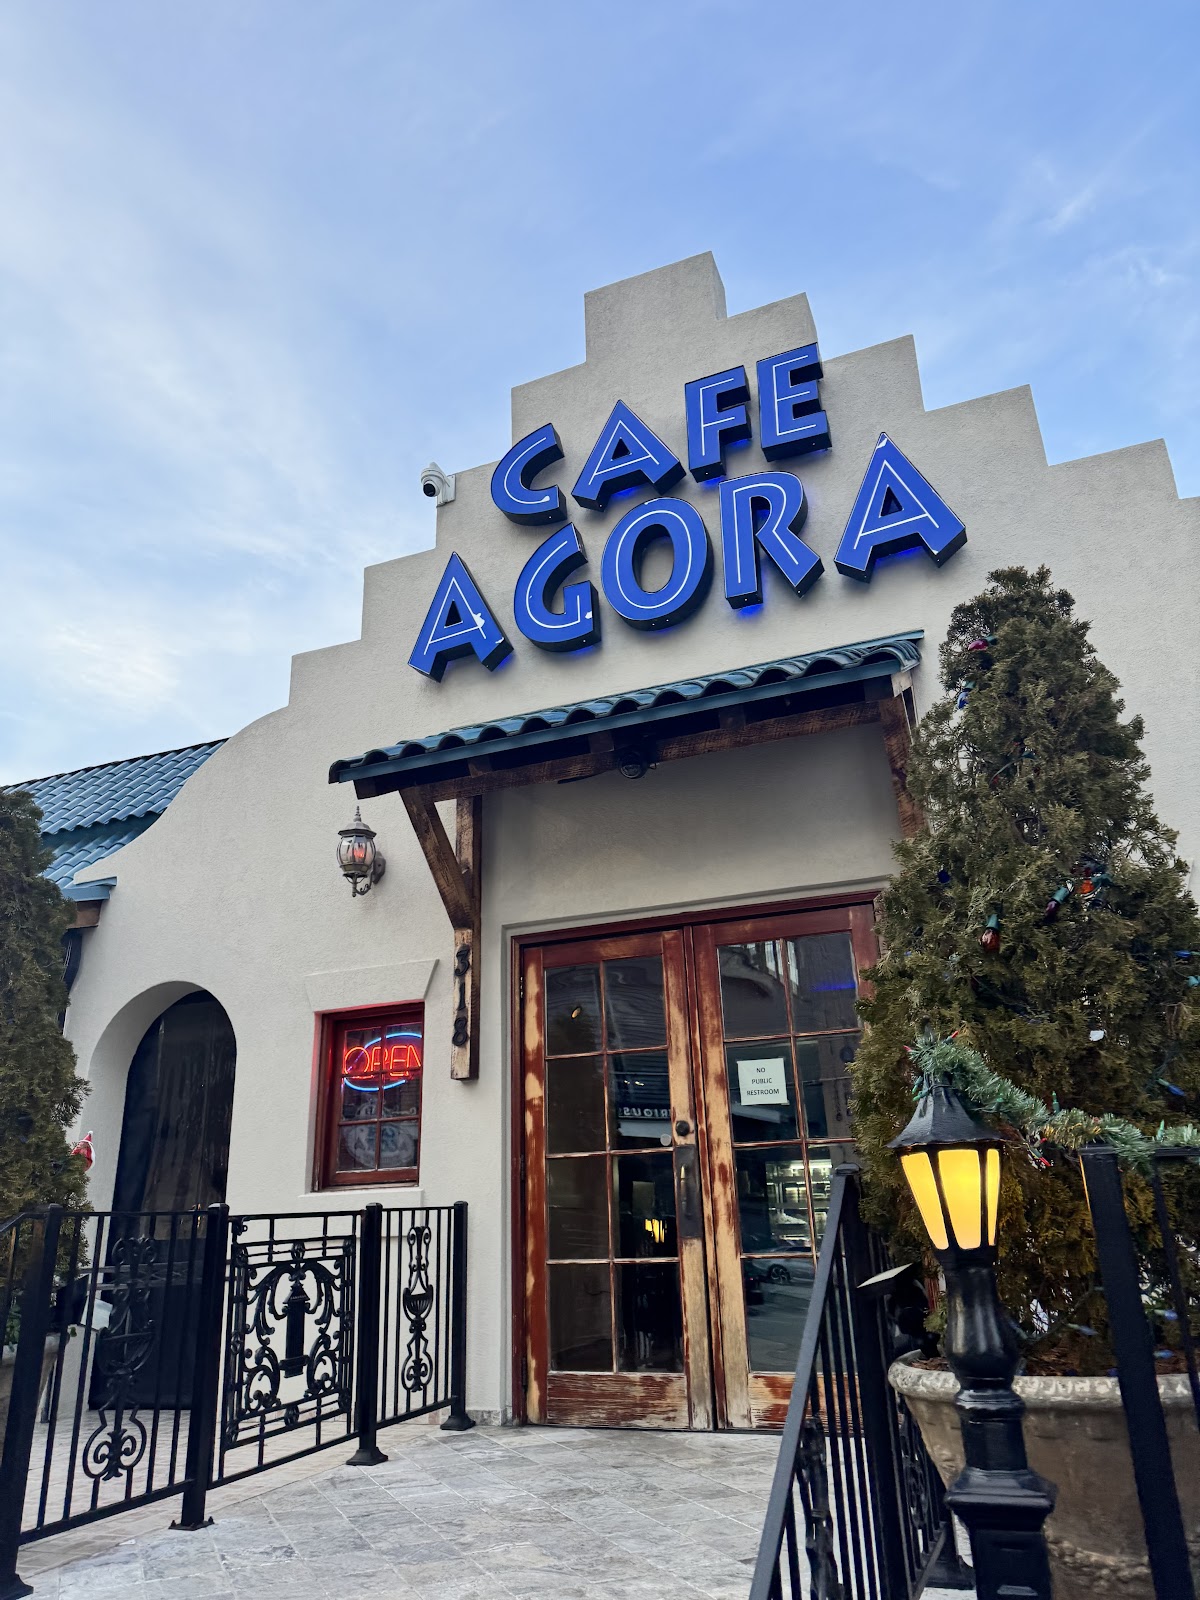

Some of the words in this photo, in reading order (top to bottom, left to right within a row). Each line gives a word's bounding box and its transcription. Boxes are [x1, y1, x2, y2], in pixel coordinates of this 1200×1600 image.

[490, 342, 831, 525] CAFE
[407, 432, 967, 682] AGORA
[344, 1045, 421, 1079] OPEN
[452, 944, 471, 1046] 318
